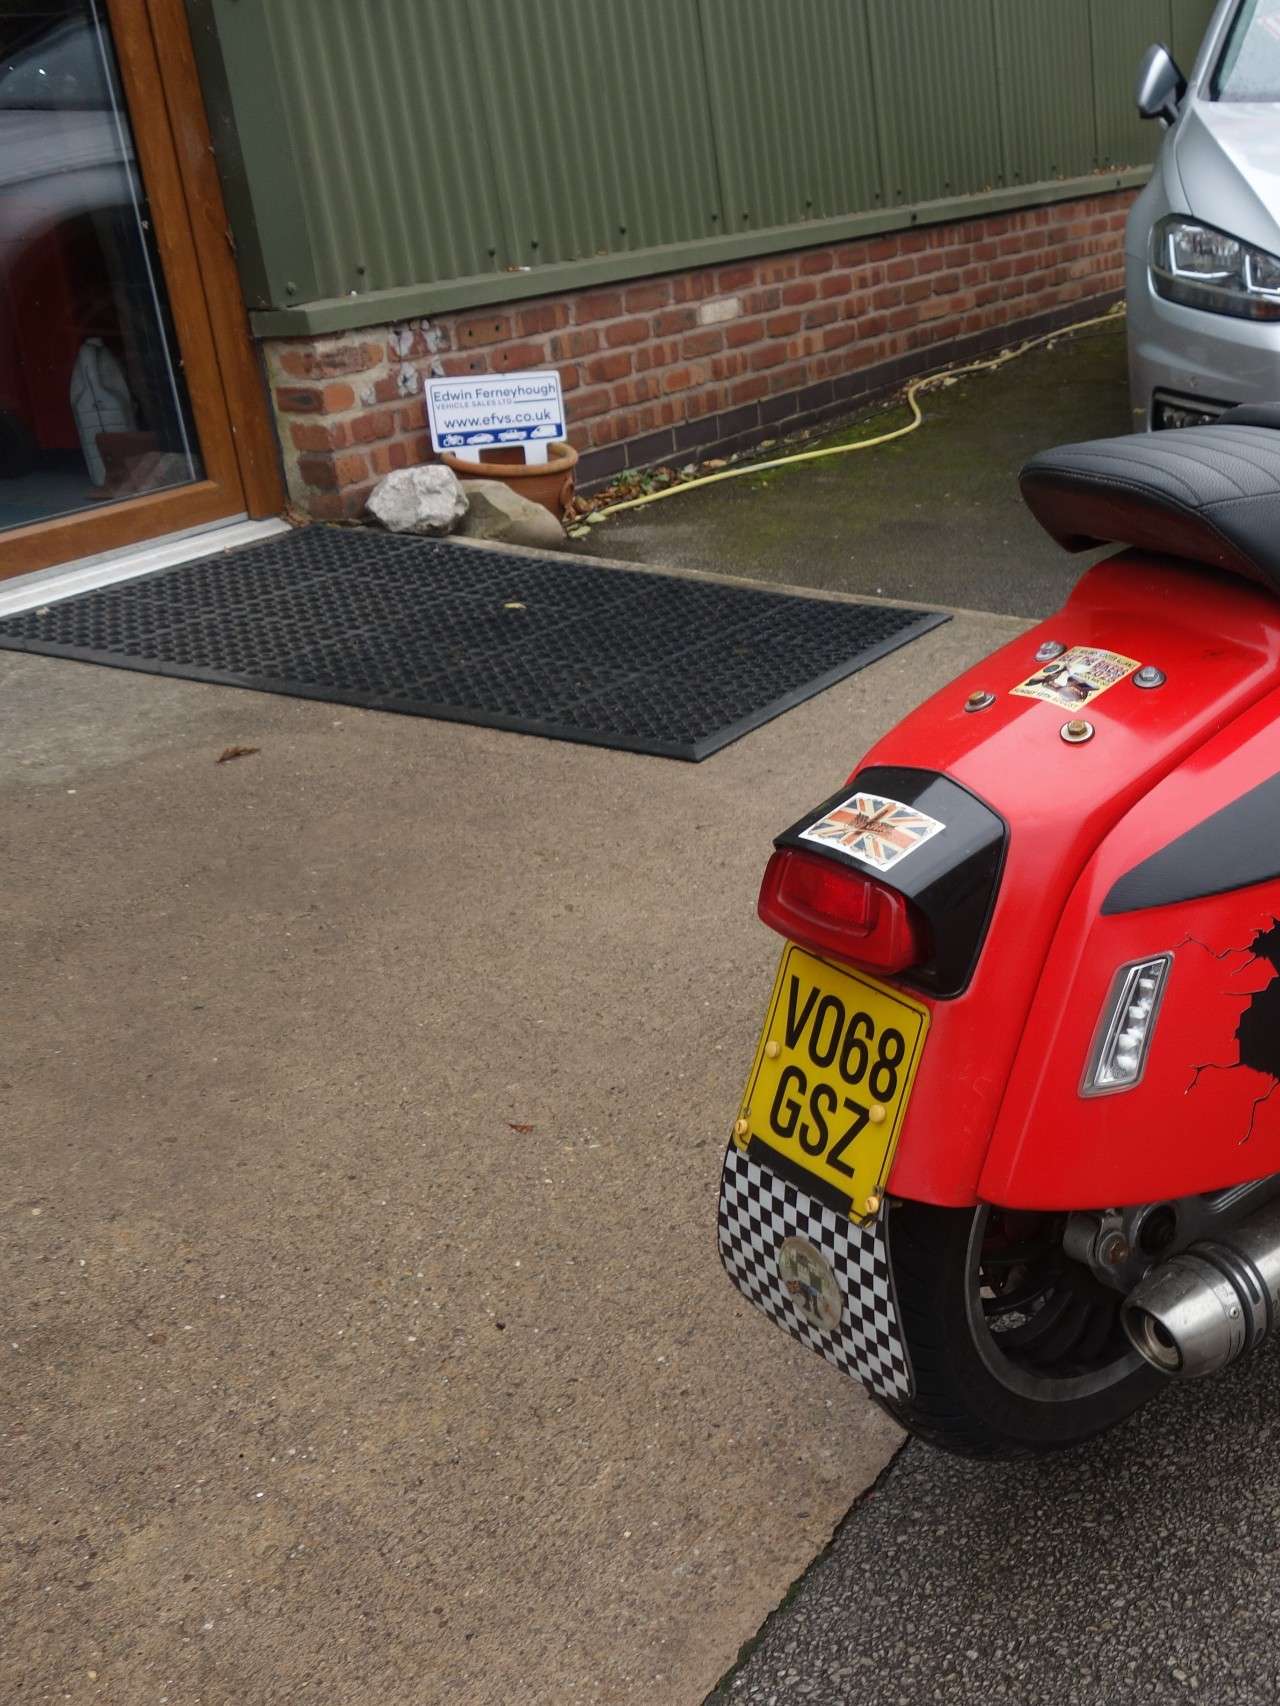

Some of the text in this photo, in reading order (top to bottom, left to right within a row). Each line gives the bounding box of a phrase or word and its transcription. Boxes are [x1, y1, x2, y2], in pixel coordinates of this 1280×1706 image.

[433, 383, 556, 402] Edwin Ferneyhough
[436, 402, 469, 411] VEHICLE
[471, 400, 496, 408] SALES
[444, 409, 551, 429] www.efvs.co.uk
[769, 1065, 872, 1178] GSZ
